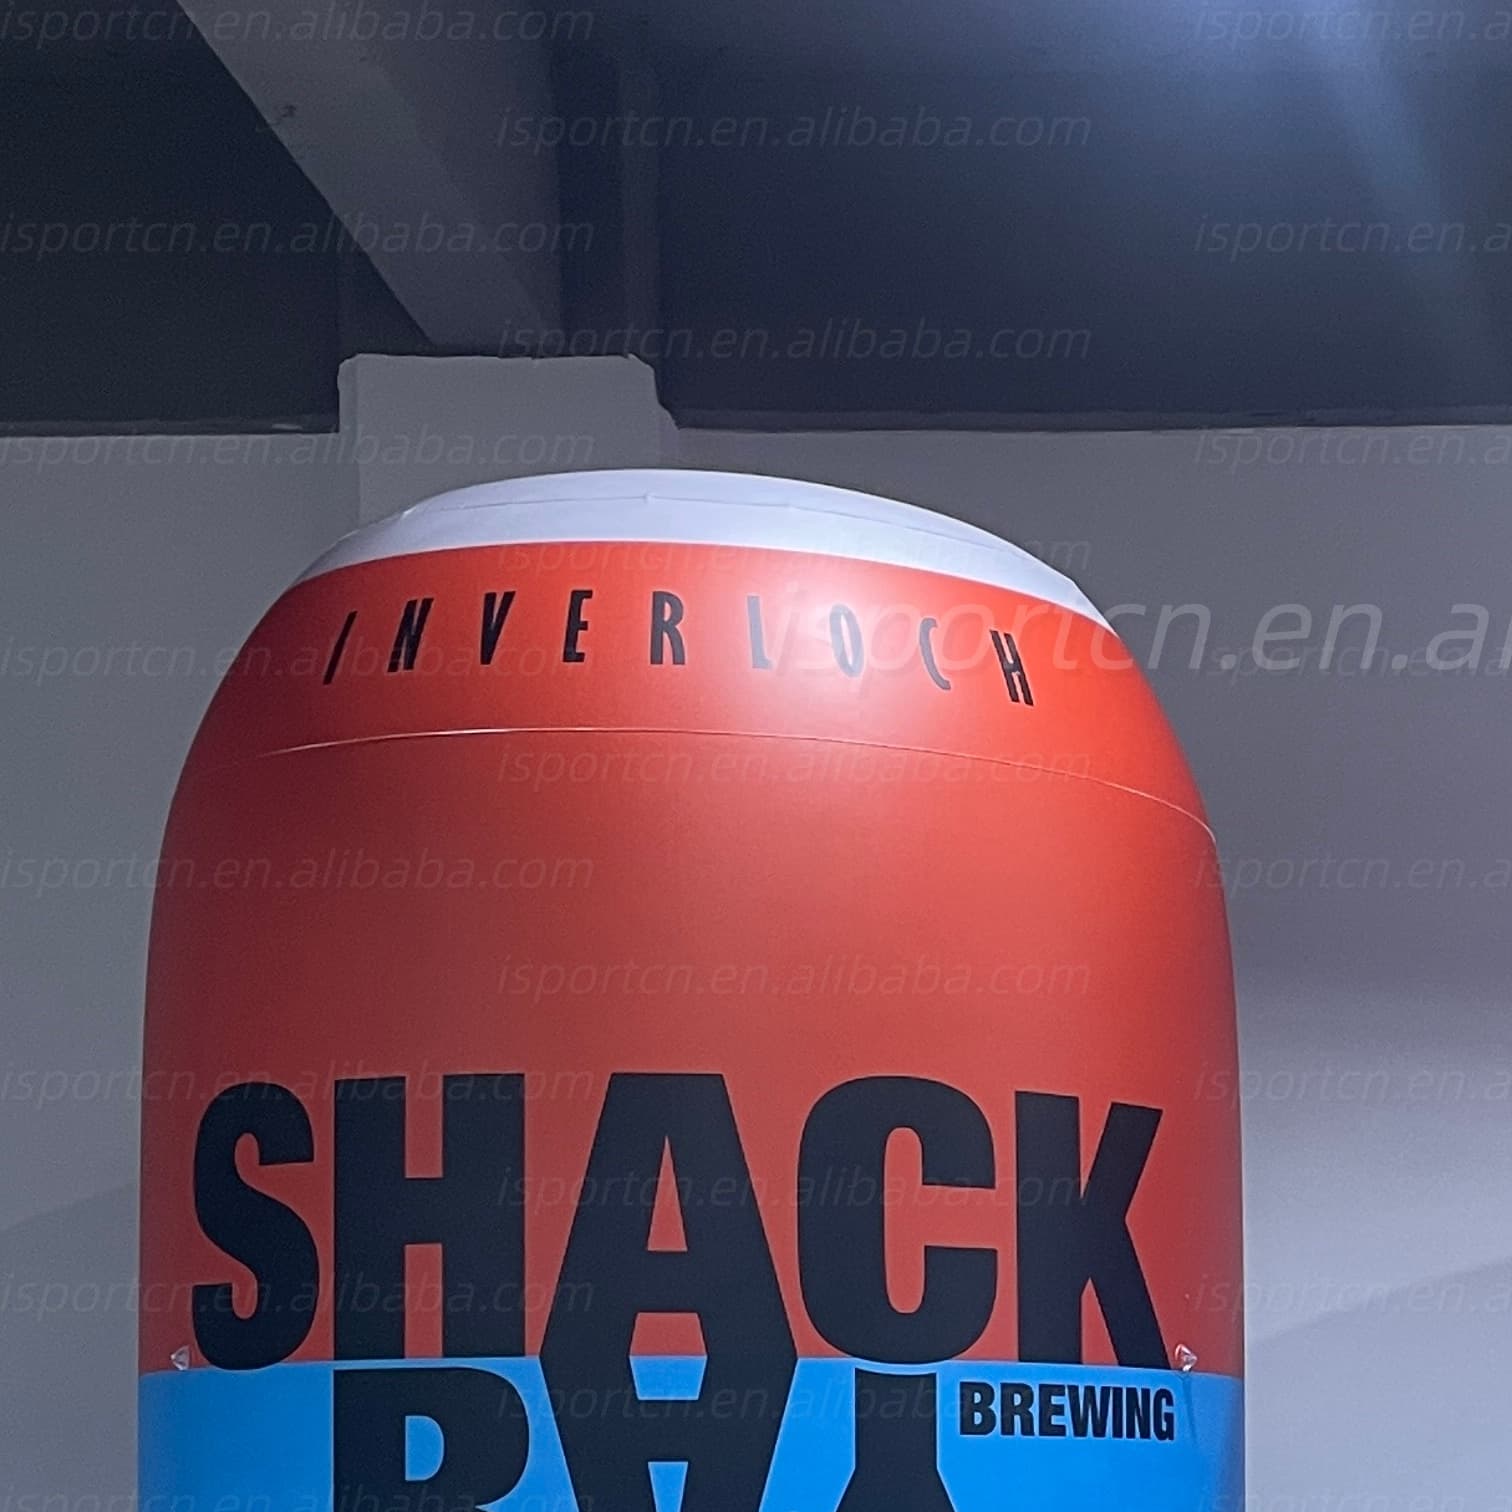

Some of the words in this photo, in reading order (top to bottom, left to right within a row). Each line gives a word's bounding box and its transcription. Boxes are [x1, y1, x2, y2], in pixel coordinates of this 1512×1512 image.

[322, 589, 1035, 707] INVERLOCH
[192, 1072, 1172, 1371] SHACK
[958, 1380, 1176, 1442] BREWING
